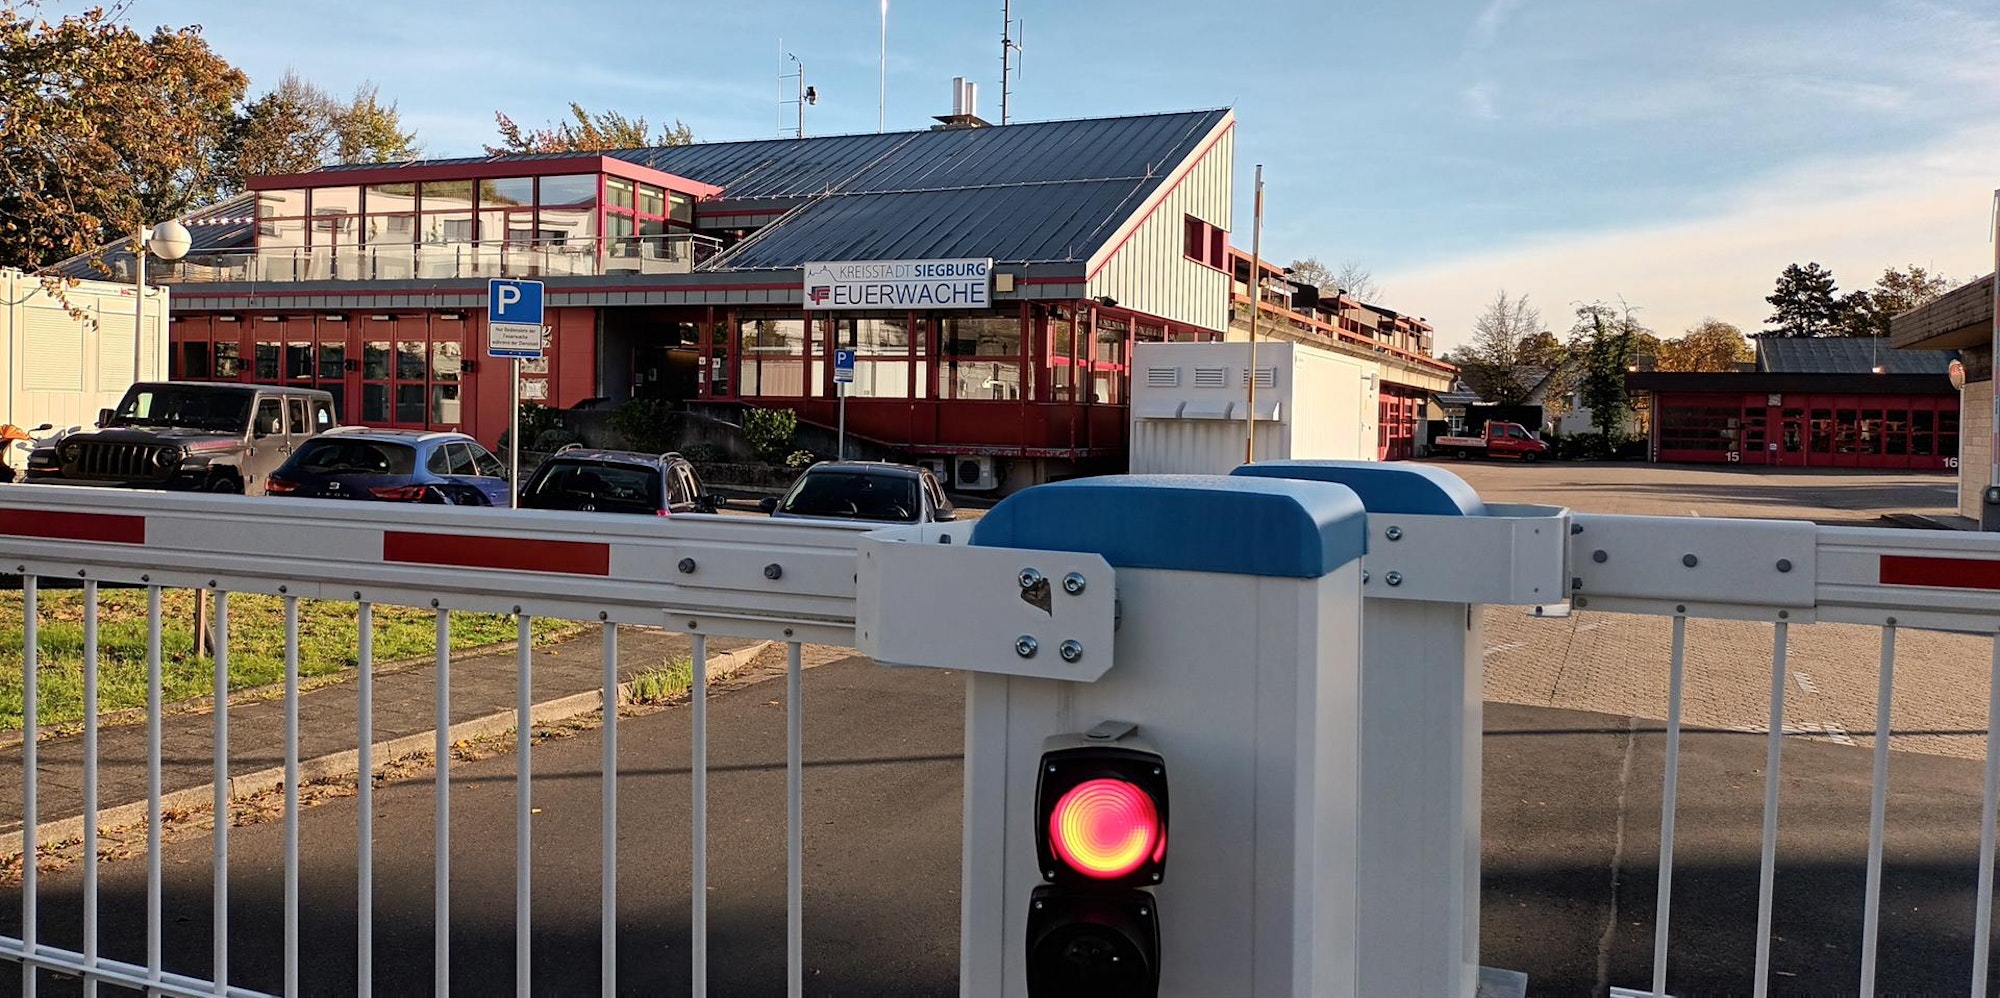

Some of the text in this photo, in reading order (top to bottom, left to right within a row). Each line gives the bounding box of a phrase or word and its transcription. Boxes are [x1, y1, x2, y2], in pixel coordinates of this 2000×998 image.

[839, 263, 986, 279] KREISSTADT SIEGBURG
[498, 285, 521, 314] P
[837, 351, 847, 365] P
[1725, 451, 1740, 462] 15
[1942, 457, 1958, 468] 16
